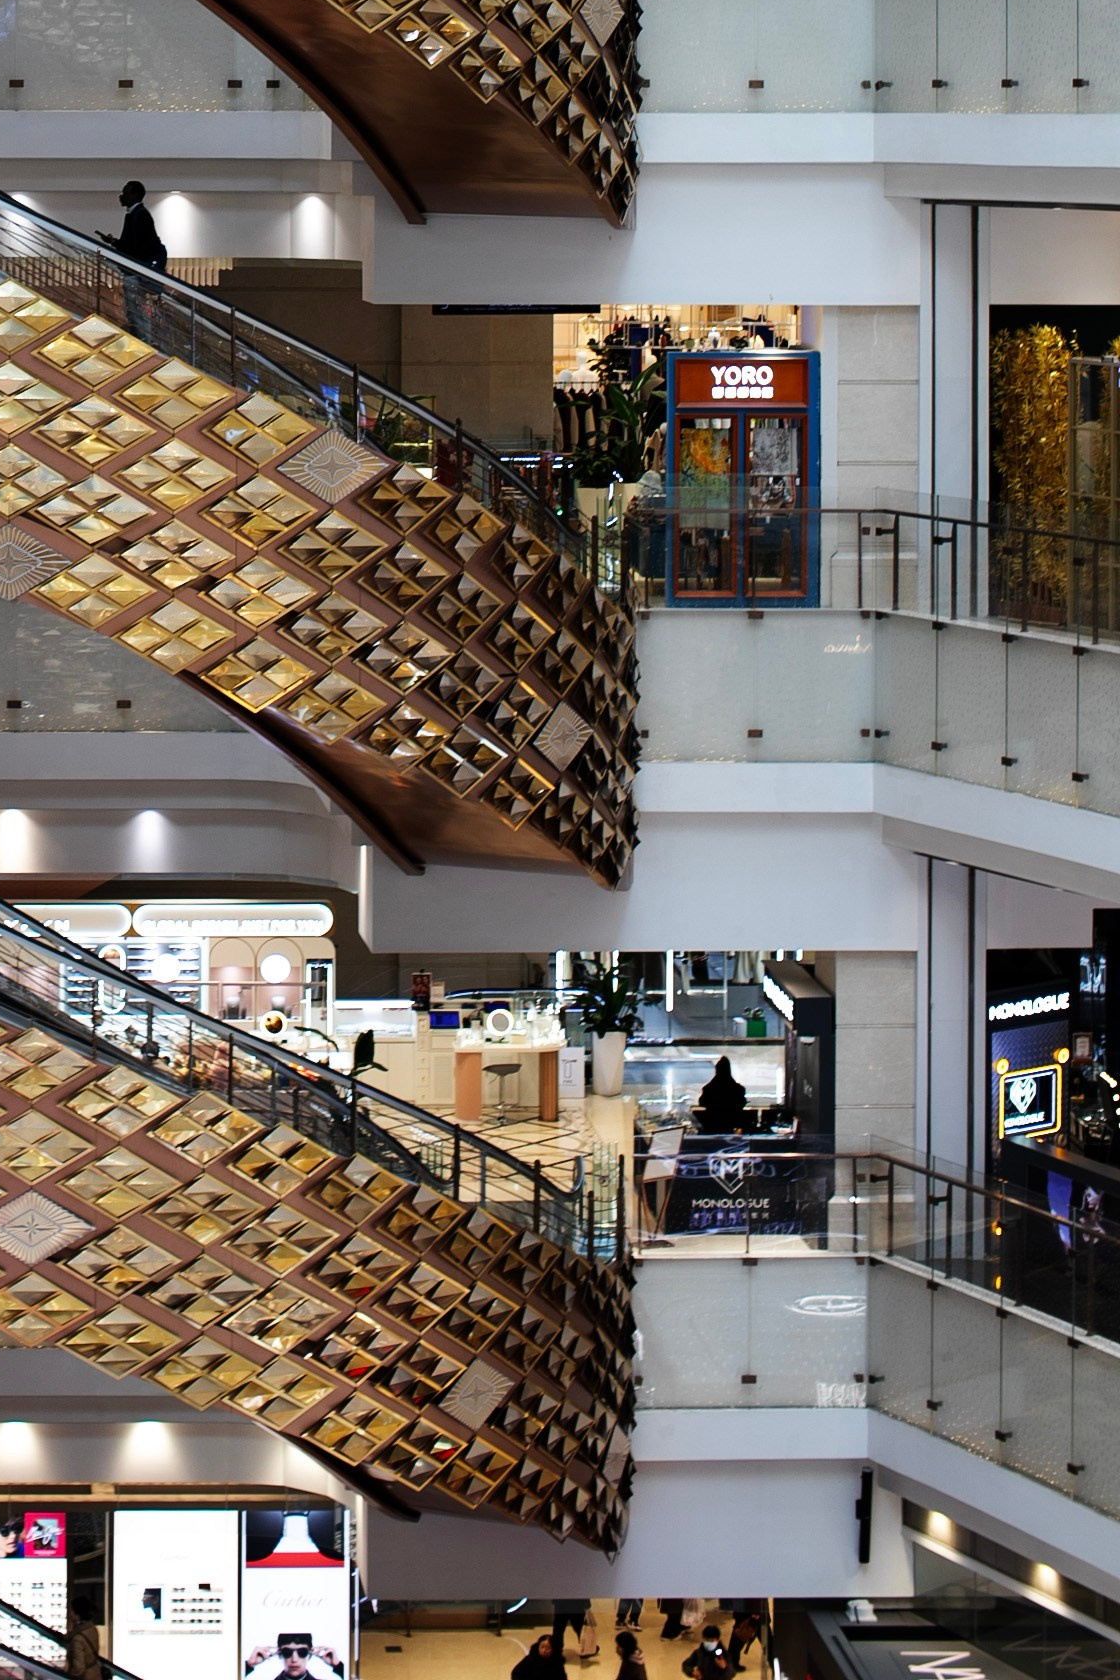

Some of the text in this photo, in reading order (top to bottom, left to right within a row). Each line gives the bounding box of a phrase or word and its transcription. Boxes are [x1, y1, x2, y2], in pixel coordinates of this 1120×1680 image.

[710, 365, 774, 386] YORO
[988, 991, 1070, 1021] MONOLOGUE
[692, 1198, 770, 1209] MONOLOGUE
[261, 1589, 328, 1608] Cartier
